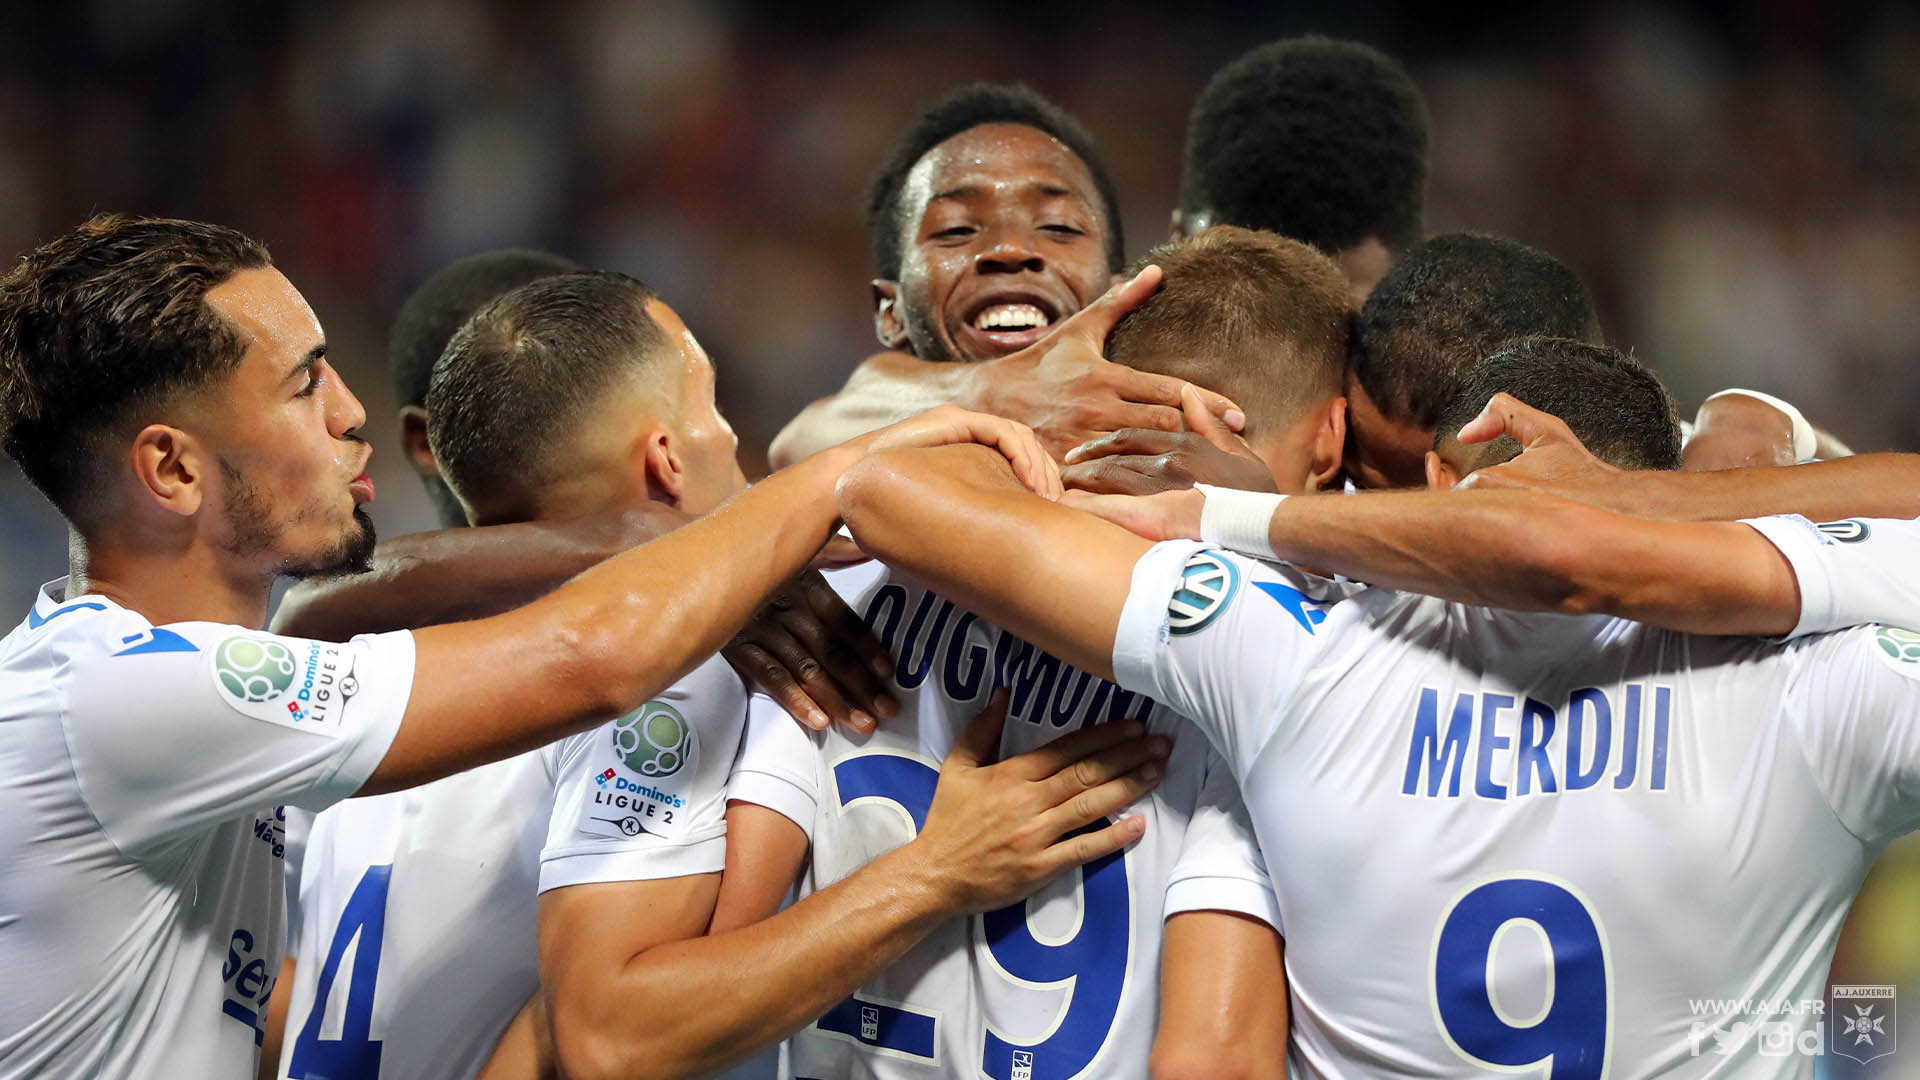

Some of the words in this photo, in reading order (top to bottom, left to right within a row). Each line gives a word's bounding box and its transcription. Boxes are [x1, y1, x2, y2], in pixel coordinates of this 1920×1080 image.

[311, 663, 337, 722] LIGUE
[326, 648, 339, 657] 2
[1401, 683, 1671, 800] MERDJI
[594, 791, 656, 818] LIGUE
[663, 810, 674, 825] 2
[615, 776, 681, 809] Domino's
[288, 863, 394, 1080] 4
[1434, 876, 1610, 1080] 9
